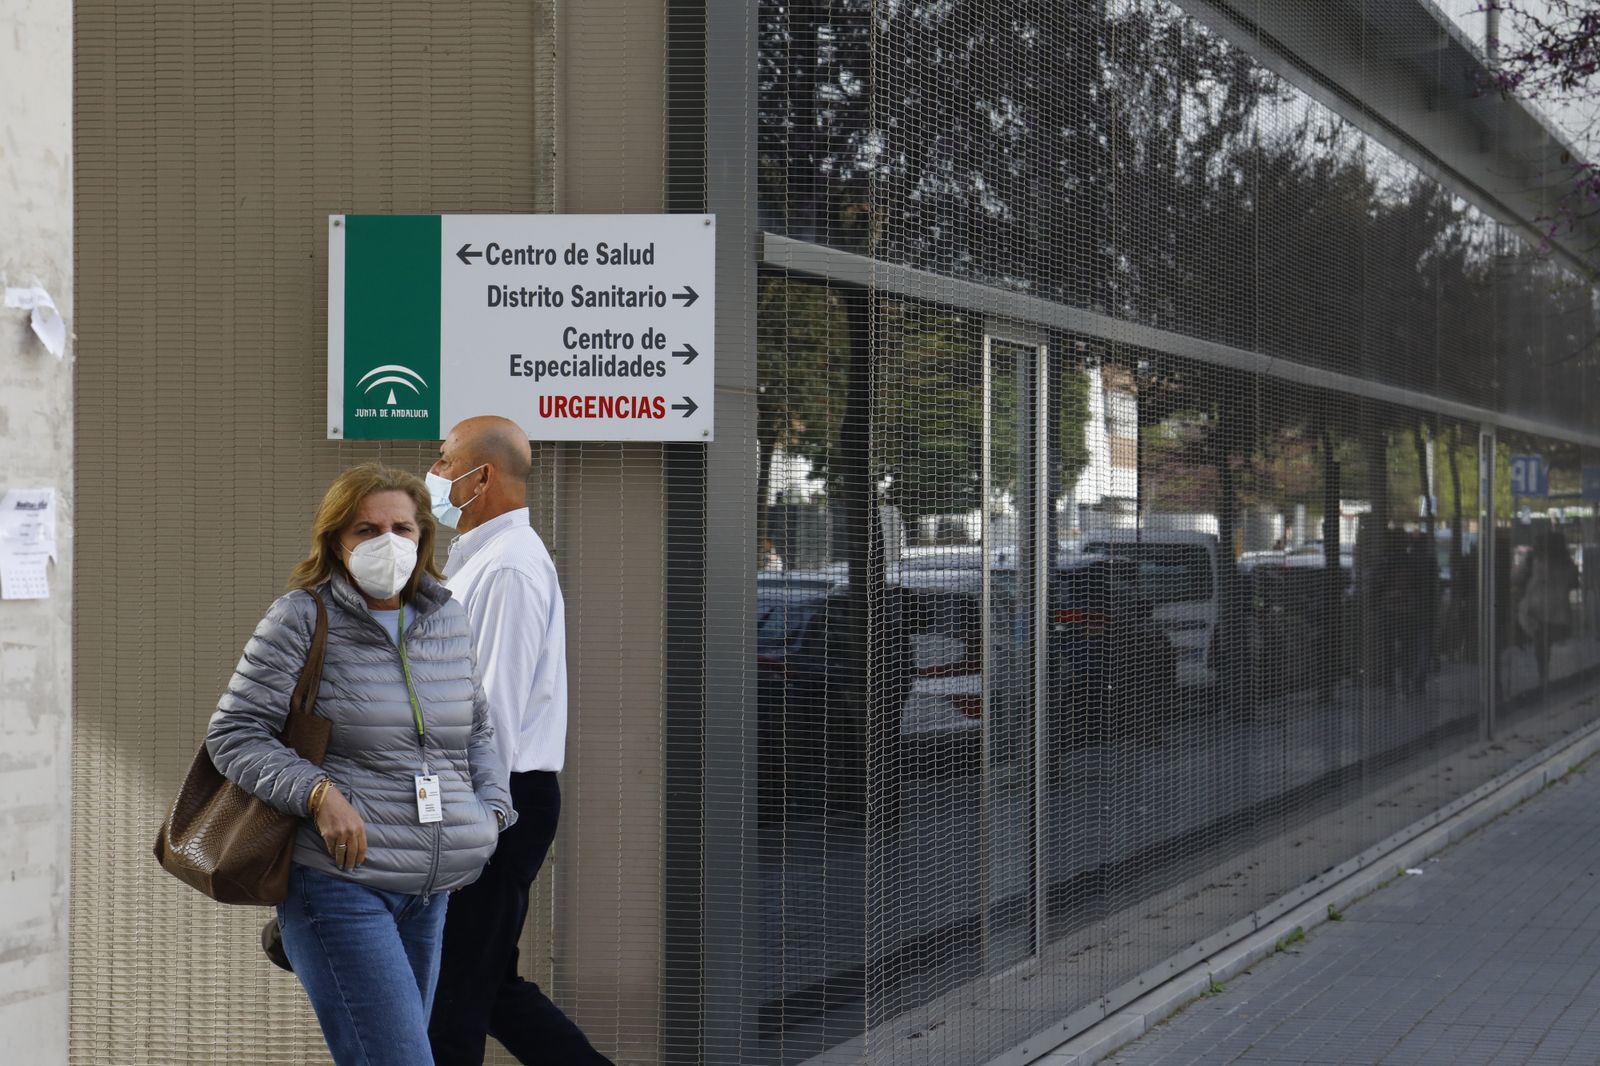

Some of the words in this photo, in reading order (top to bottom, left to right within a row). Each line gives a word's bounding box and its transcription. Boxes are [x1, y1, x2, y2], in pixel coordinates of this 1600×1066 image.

[485, 242, 557, 266] Centro
[563, 242, 589, 266] de
[596, 242, 655, 266] Salud
[487, 284, 564, 308] Distrito
[571, 284, 667, 308] Sanitario
[562, 326, 634, 350] Centro
[641, 326, 667, 350] de
[509, 354, 667, 382] Especialidades
[355, 408, 377, 418] JUNTA
[379, 408, 389, 418] DE
[538, 395, 667, 419] URGENCIAS
